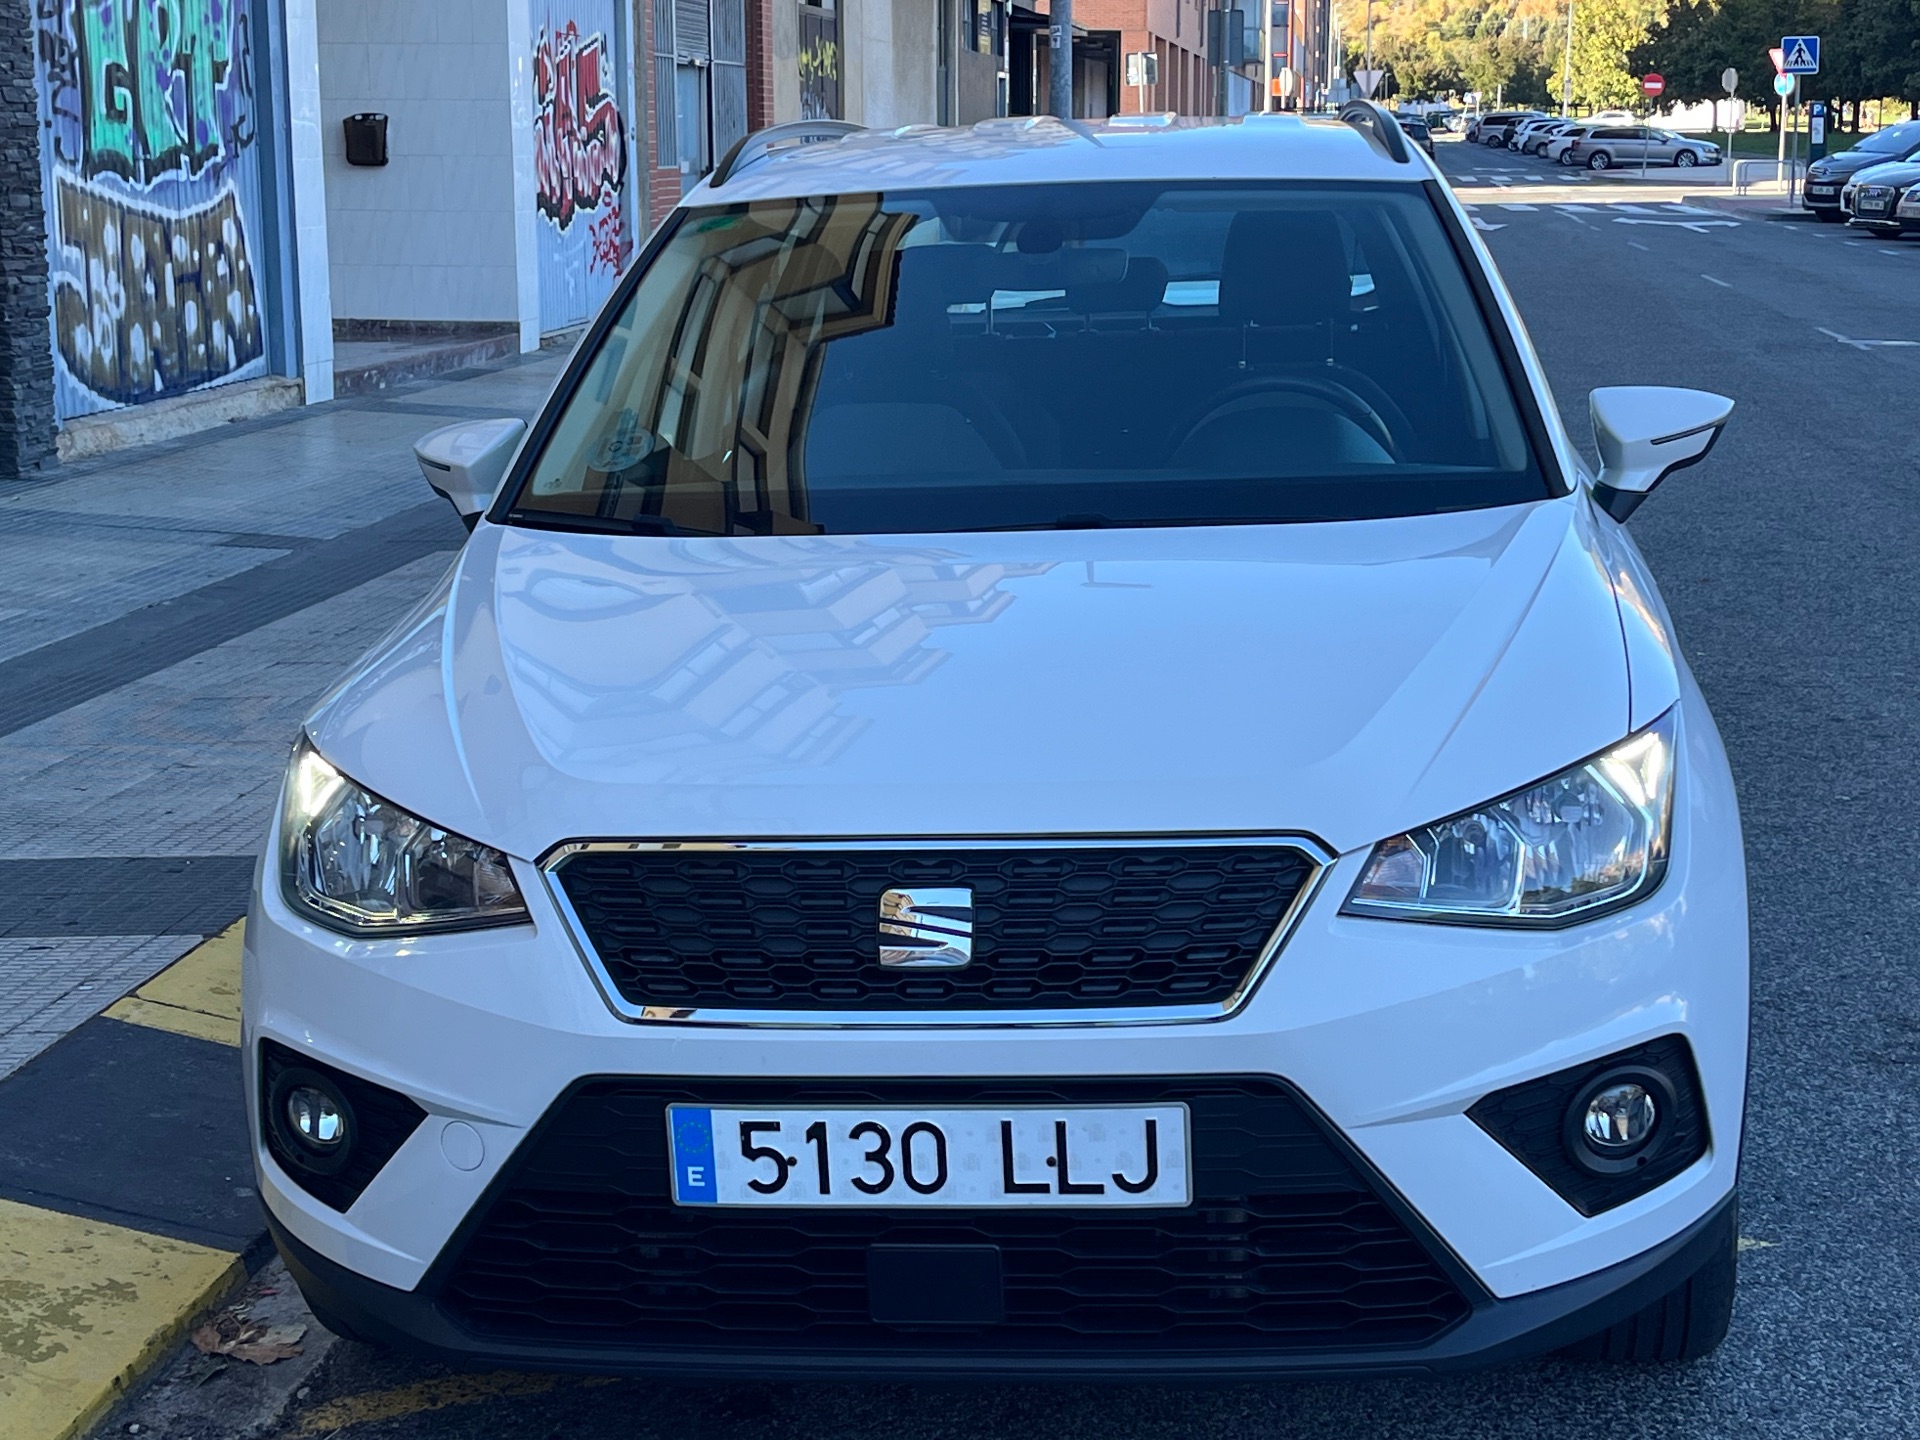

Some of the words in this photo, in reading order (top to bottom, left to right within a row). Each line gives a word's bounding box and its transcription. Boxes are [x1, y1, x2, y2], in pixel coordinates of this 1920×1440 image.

[1813, 104, 1822, 116] P
[739, 1120, 948, 1195] 5130
[1000, 1118, 1158, 1195] LLJ
[687, 1166, 706, 1187] E
